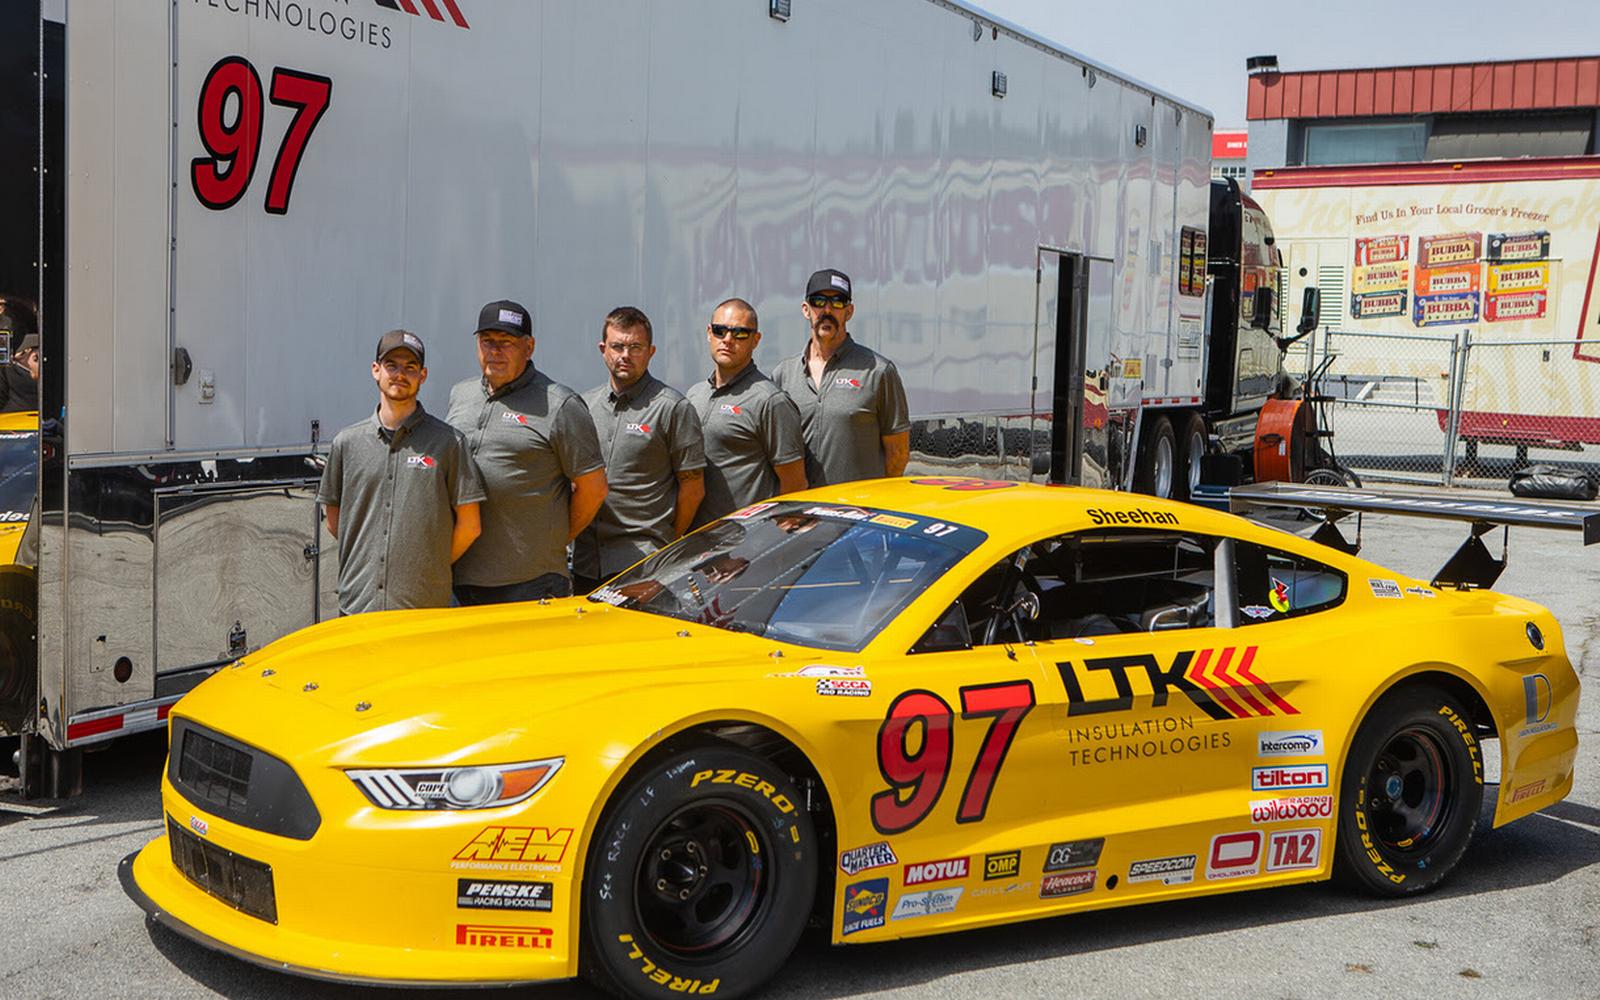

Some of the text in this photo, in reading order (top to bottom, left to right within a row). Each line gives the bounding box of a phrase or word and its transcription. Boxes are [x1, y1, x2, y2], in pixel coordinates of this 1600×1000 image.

[195, 0, 392, 48] CHNOLOGIES
[191, 55, 332, 215] 97
[1355, 203, 1550, 225] Find Us In Your Local Grocer's Freezer
[1432, 242, 1471, 255] BUBBA
[1504, 243, 1538, 253] BUBBA
[1367, 270, 1398, 280] BUBBA
[1432, 276, 1467, 285] BUBBA
[1500, 270, 1540, 281] BUBBA
[1364, 298, 1398, 308] BUBBA
[1427, 301, 1471, 313] BUBBA
[1501, 300, 1535, 309] BUBBA
[1086, 508, 1179, 525] Sheehan
[923, 522, 958, 538] 97
[831, 680, 869, 688] SCCA
[1056, 650, 1235, 721] LTK
[1068, 715, 1194, 744] INSULATION
[1069, 731, 1232, 767] TECHNOLOGIES
[1261, 740, 1311, 752] Intercomp
[1438, 705, 1484, 784] PIRELLI
[870, 679, 1036, 836] 97
[1256, 770, 1322, 786] tilton
[418, 783, 446, 792] COPE
[1289, 796, 1328, 804] RACING
[1252, 797, 1332, 822] wilwood
[451, 826, 574, 863] AEM
[1273, 833, 1316, 866] TA2
[842, 843, 888, 867] QUARTER
[850, 852, 894, 873] MASTER
[1050, 848, 1071, 864] CG
[450, 861, 561, 872] PERFORMANCE ELECTRONICS
[906, 859, 967, 884] MOTUL
[987, 858, 1018, 873] OMP
[1130, 857, 1195, 875] SPEEDCOM
[1046, 872, 1092, 890] Heacock
[466, 883, 545, 898] PENSKE
[474, 897, 536, 907] RACING SHOCKS
[846, 895, 885, 913] SUNOCO
[860, 915, 884, 929] FUELS
[456, 924, 554, 949] PIRELLI
[618, 933, 721, 994] PIRELLI
